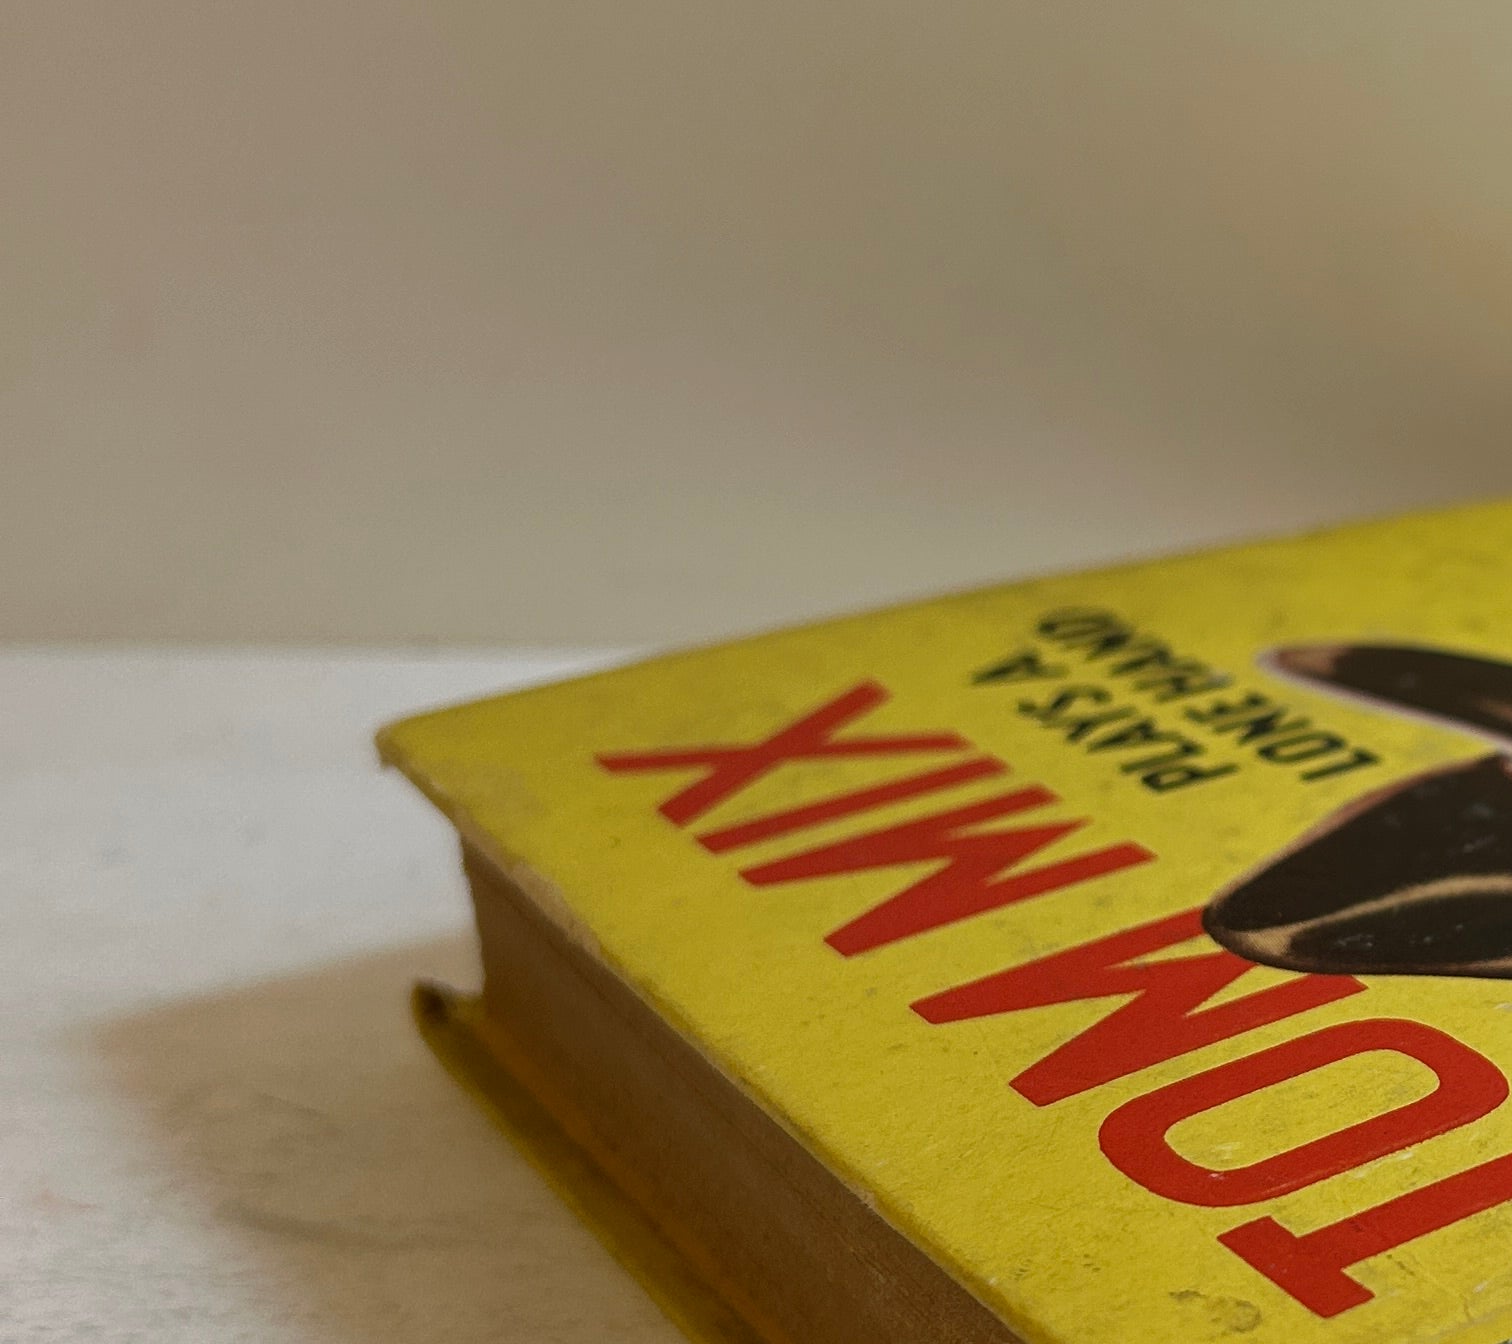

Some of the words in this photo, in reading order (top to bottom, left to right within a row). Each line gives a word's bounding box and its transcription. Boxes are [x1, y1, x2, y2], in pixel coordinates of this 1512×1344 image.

[971, 647, 1068, 686] A
[1036, 607, 1233, 703] HAND
[1016, 686, 1239, 794] PLAYS
[1183, 690, 1380, 782] LONE
[595, 680, 1157, 958] MIX
